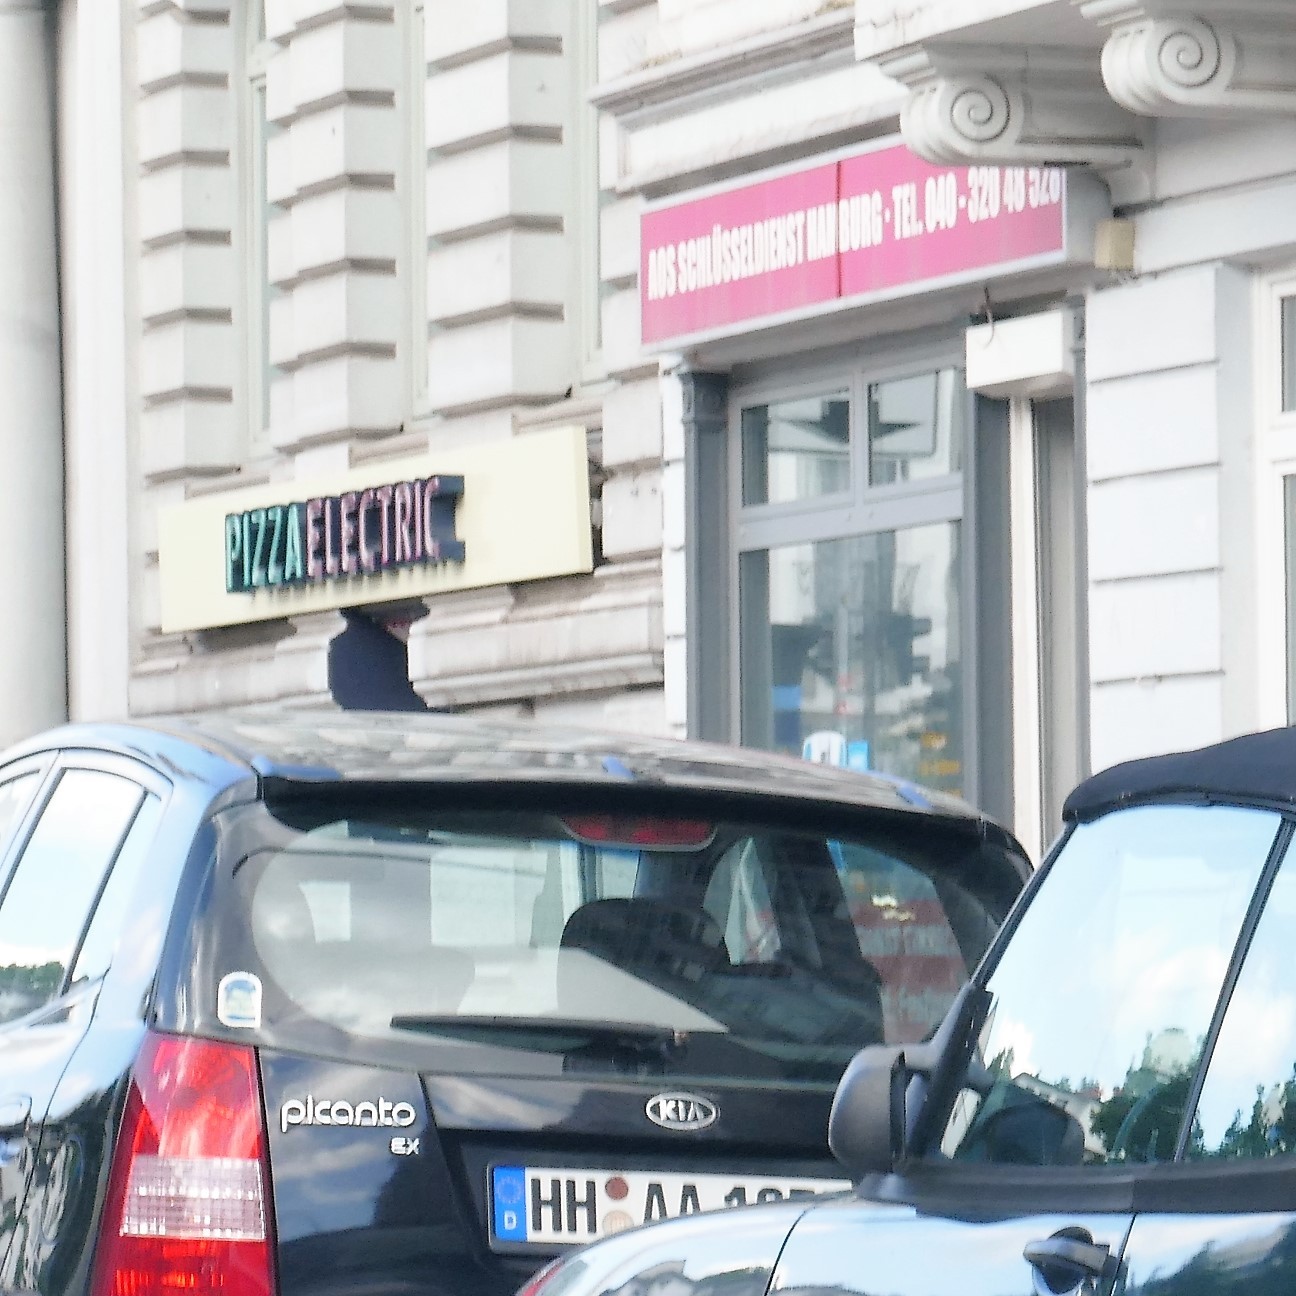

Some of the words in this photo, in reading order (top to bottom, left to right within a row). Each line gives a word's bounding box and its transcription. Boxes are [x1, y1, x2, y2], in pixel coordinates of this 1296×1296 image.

[678, 211, 804, 293] SCHLÜSSELDIENST
[807, 191, 882, 261] HAMBURG
[892, 182, 923, 240] TEL.
[925, 171, 957, 233] 040
[225, 502, 301, 593] PIZZA
[306, 475, 448, 577] ELECTRIC
[281, 1095, 415, 1133] picanto
[659, 1099, 705, 1121] KIA
[391, 1137, 420, 1155] EX
[531, 1178, 597, 1233] HH
